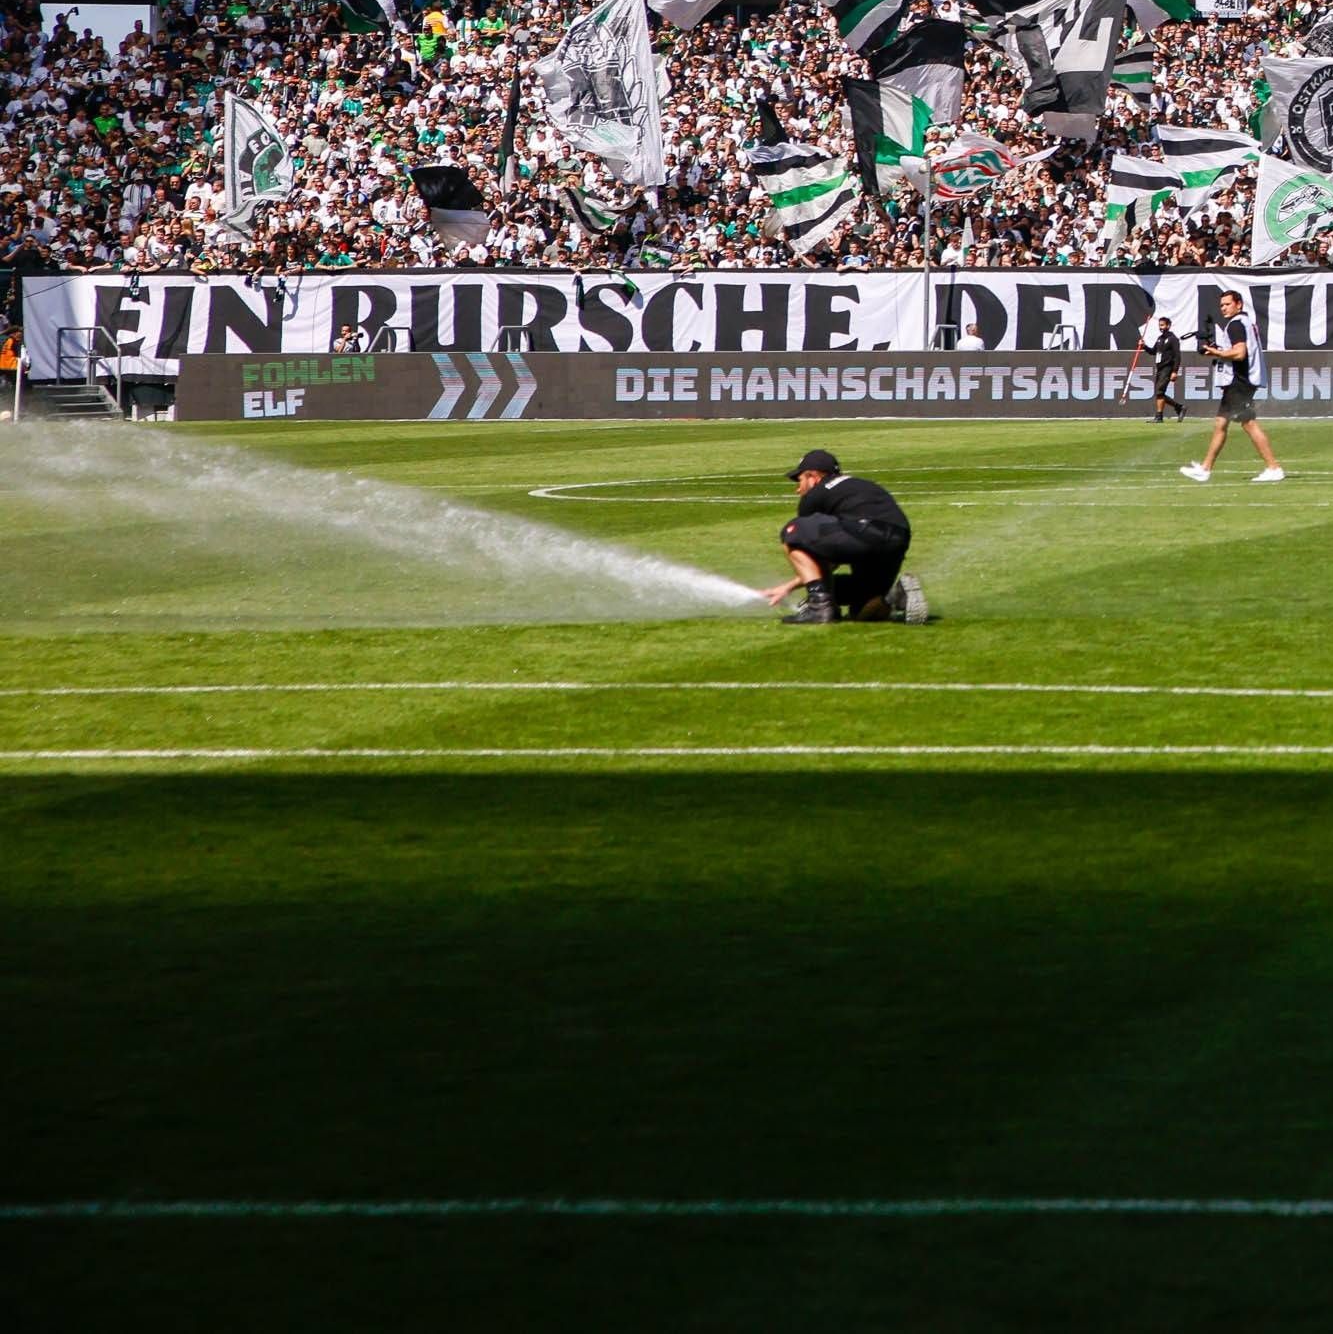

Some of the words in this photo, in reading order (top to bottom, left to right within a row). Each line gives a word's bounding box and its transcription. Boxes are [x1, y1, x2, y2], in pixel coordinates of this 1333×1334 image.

[94, 283, 284, 360] EIN
[935, 281, 1156, 352] DER
[241, 356, 376, 389] FOHLEN
[615, 367, 699, 401] DIE
[242, 387, 306, 419] ELF
